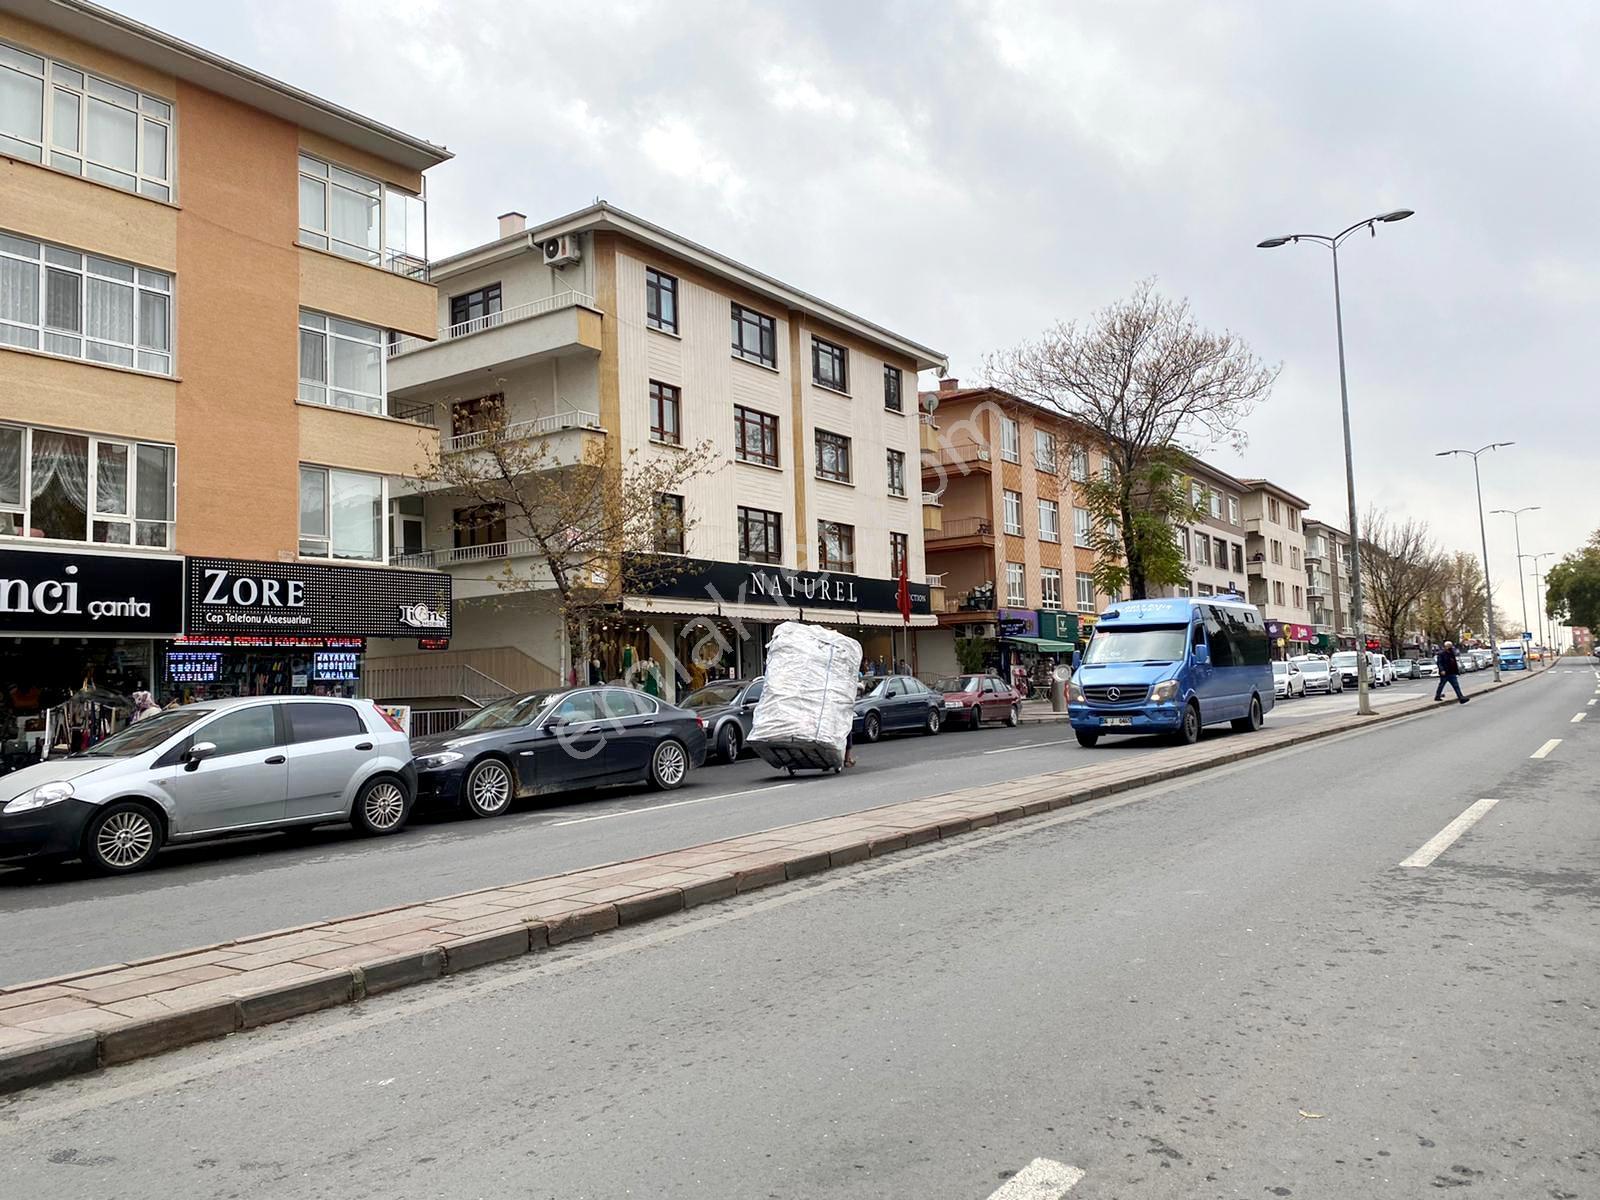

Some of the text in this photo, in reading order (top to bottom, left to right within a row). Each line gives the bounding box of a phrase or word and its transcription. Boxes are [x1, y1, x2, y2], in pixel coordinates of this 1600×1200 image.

[203, 569, 305, 607] ZORE
[751, 572, 857, 602] NATUREL
[88, 596, 151, 620] çanta
[206, 612, 312, 625] Cep Telefonu Aksesuarları
